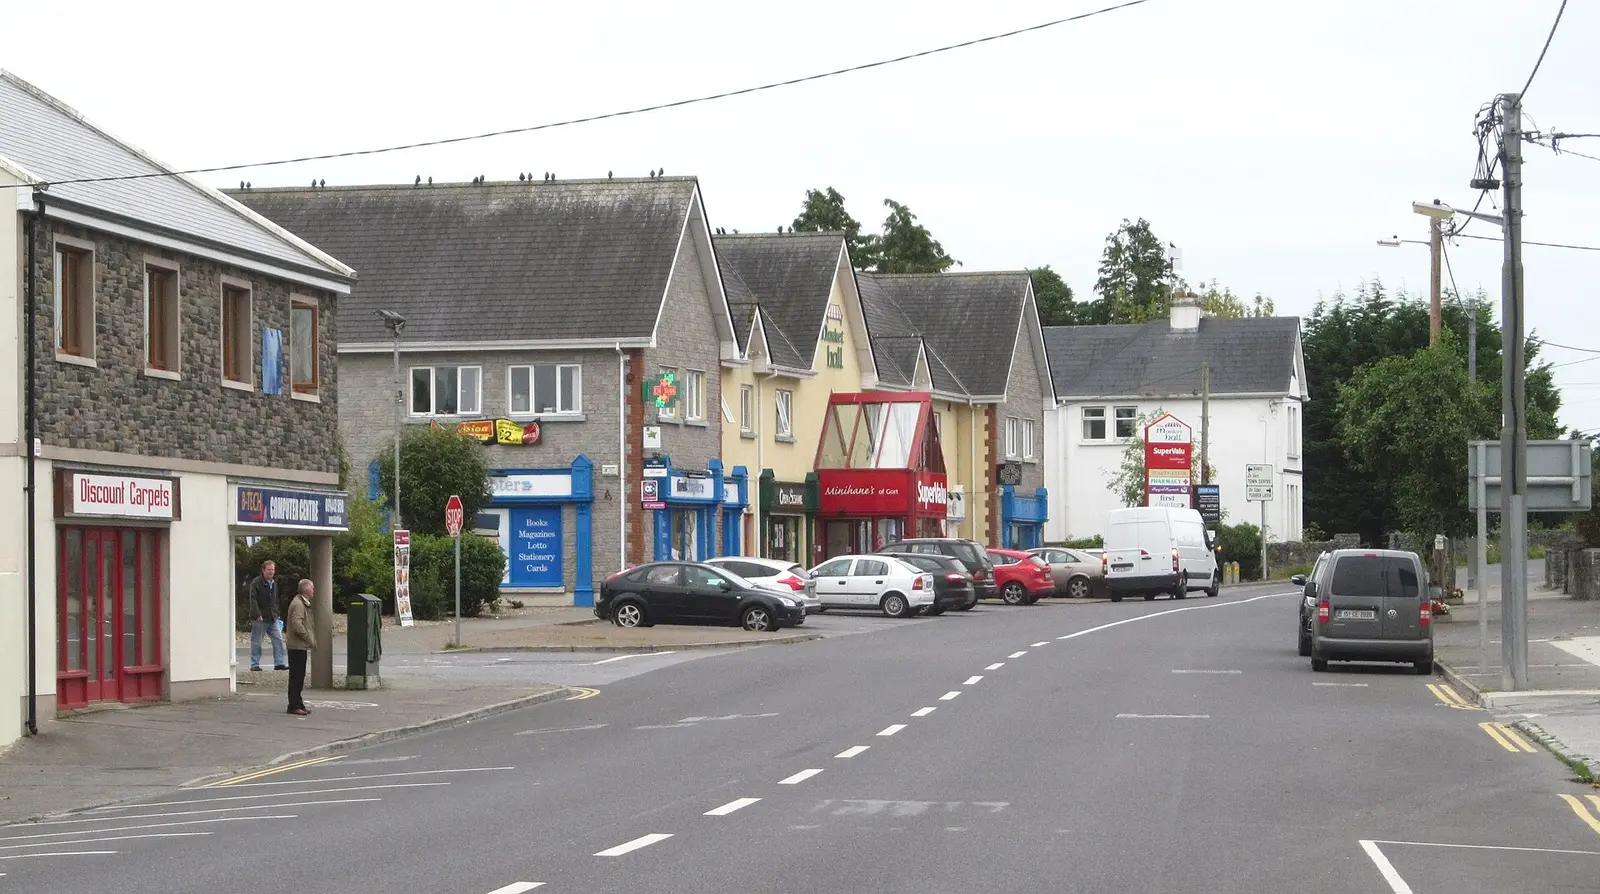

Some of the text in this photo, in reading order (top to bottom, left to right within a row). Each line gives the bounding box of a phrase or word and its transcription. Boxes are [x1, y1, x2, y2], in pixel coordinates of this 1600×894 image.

[1153, 447, 1185, 456] SuperValu
[824, 485, 874, 495] Minihane's
[917, 480, 947, 509] SuperValu
[80, 478, 169, 512] Discount Carpets
[270, 496, 299, 521] COMPUTER
[299, 498, 319, 522] CENTRE
[447, 509, 462, 524] STOP
[526, 519, 548, 527] Books
[519, 530, 556, 539] Magazines
[519, 553, 555, 562] Stationery
[526, 564, 548, 572] Cards
